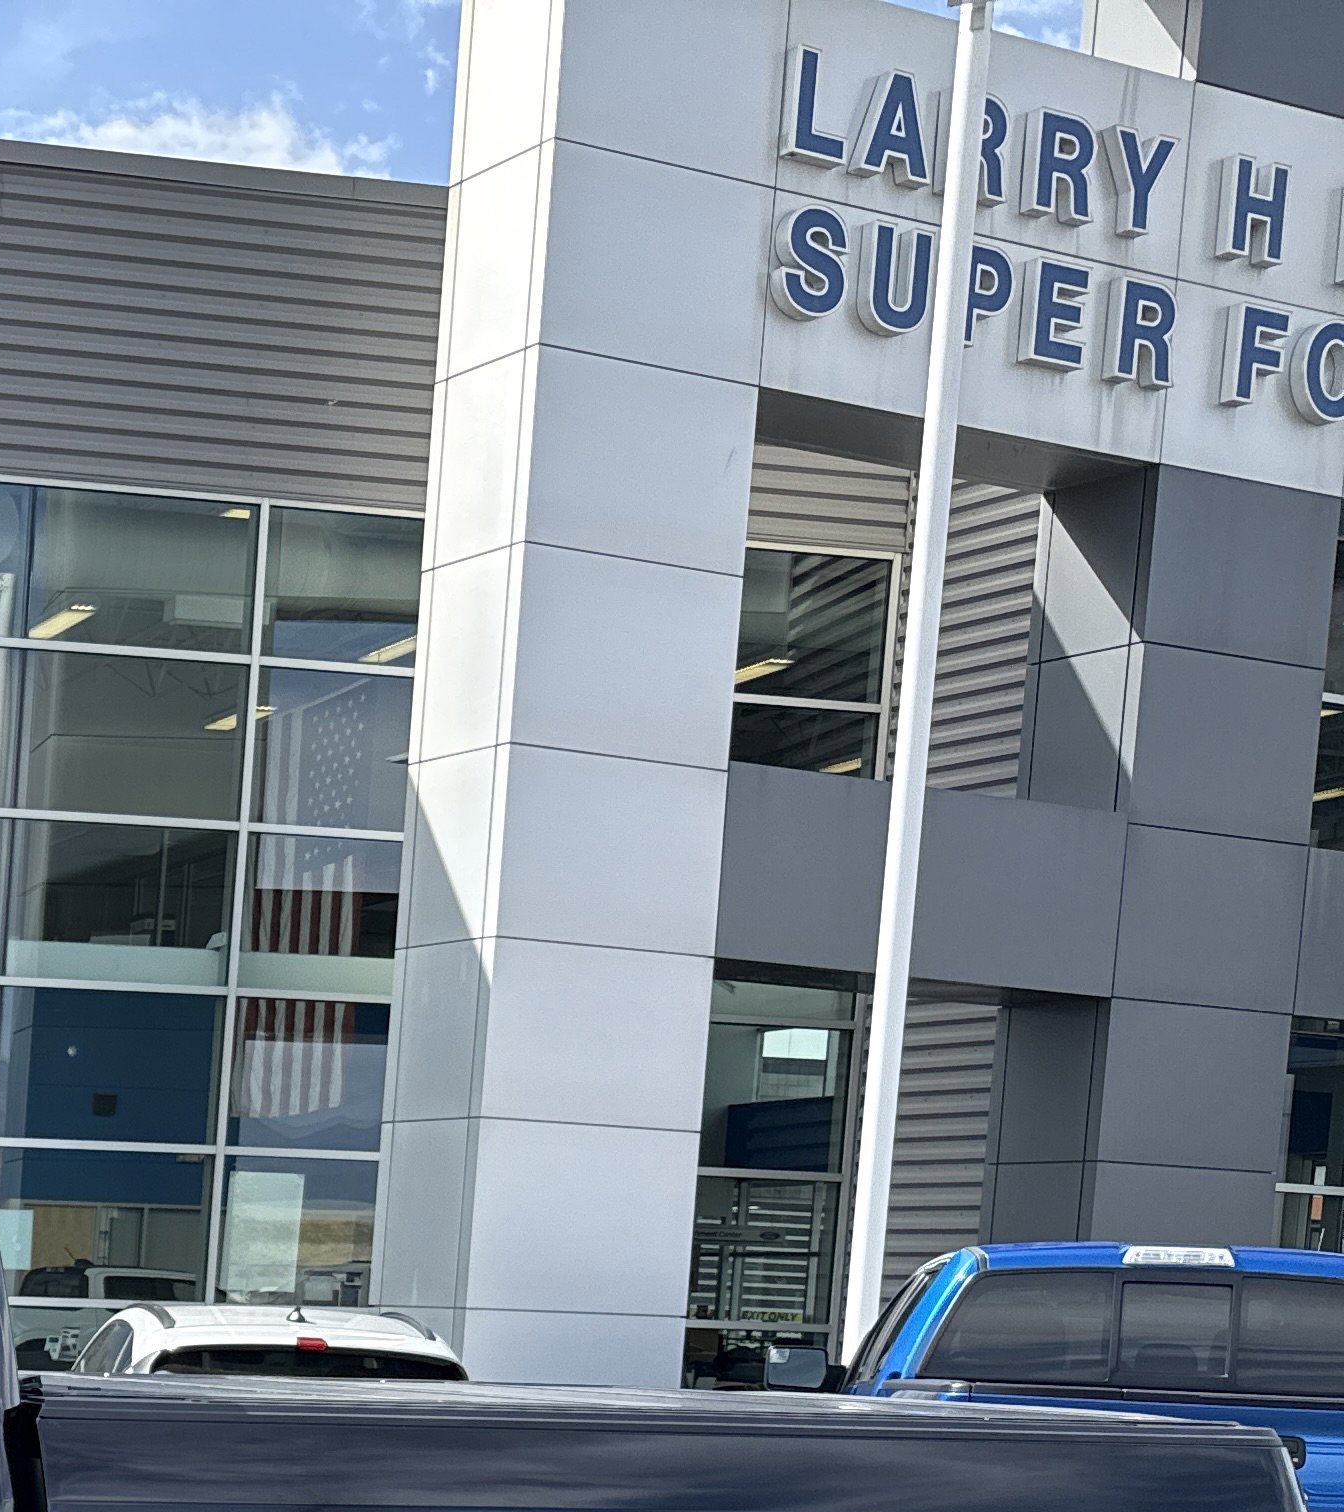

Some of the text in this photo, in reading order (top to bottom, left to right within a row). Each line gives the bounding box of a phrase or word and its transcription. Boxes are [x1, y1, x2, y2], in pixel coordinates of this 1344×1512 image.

[1215, 152, 1293, 268] H
[770, 203, 1179, 390] SUPER
[742, 1310, 800, 1322] EXIT ONLY
